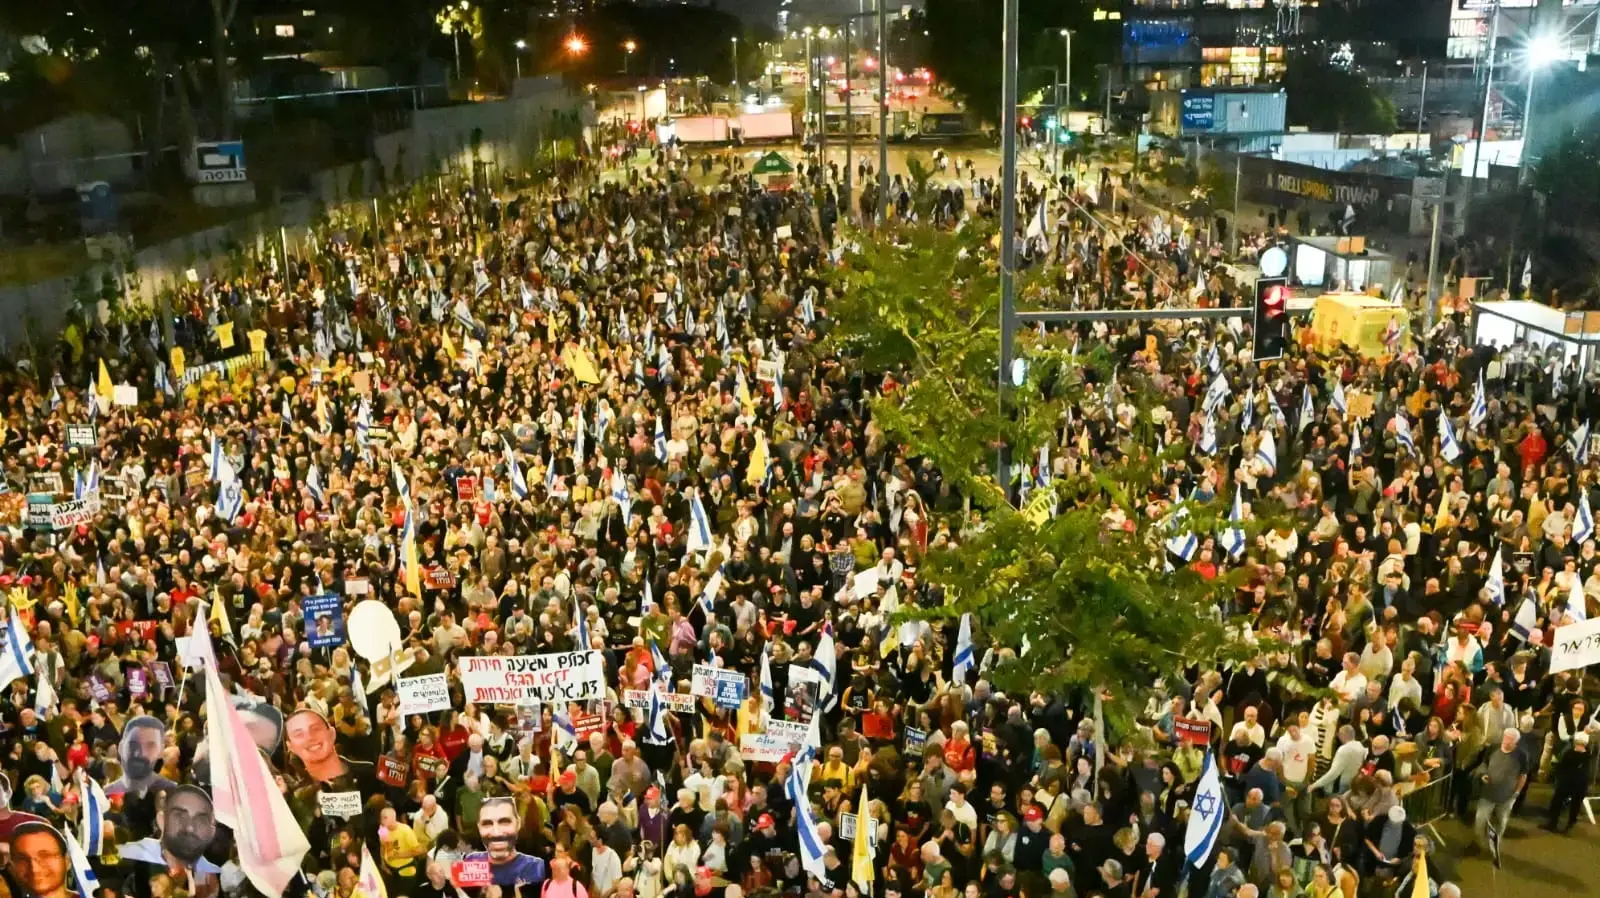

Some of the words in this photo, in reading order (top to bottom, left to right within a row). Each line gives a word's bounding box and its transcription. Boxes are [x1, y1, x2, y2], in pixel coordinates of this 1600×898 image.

[468, 658, 502, 673] חירות
[506, 657, 548, 671] מגיעה
[559, 651, 594, 668] לכולם
[505, 672, 535, 686] הבדל
[464, 863, 487, 872] עדיין
[463, 872, 488, 880] בעזה
